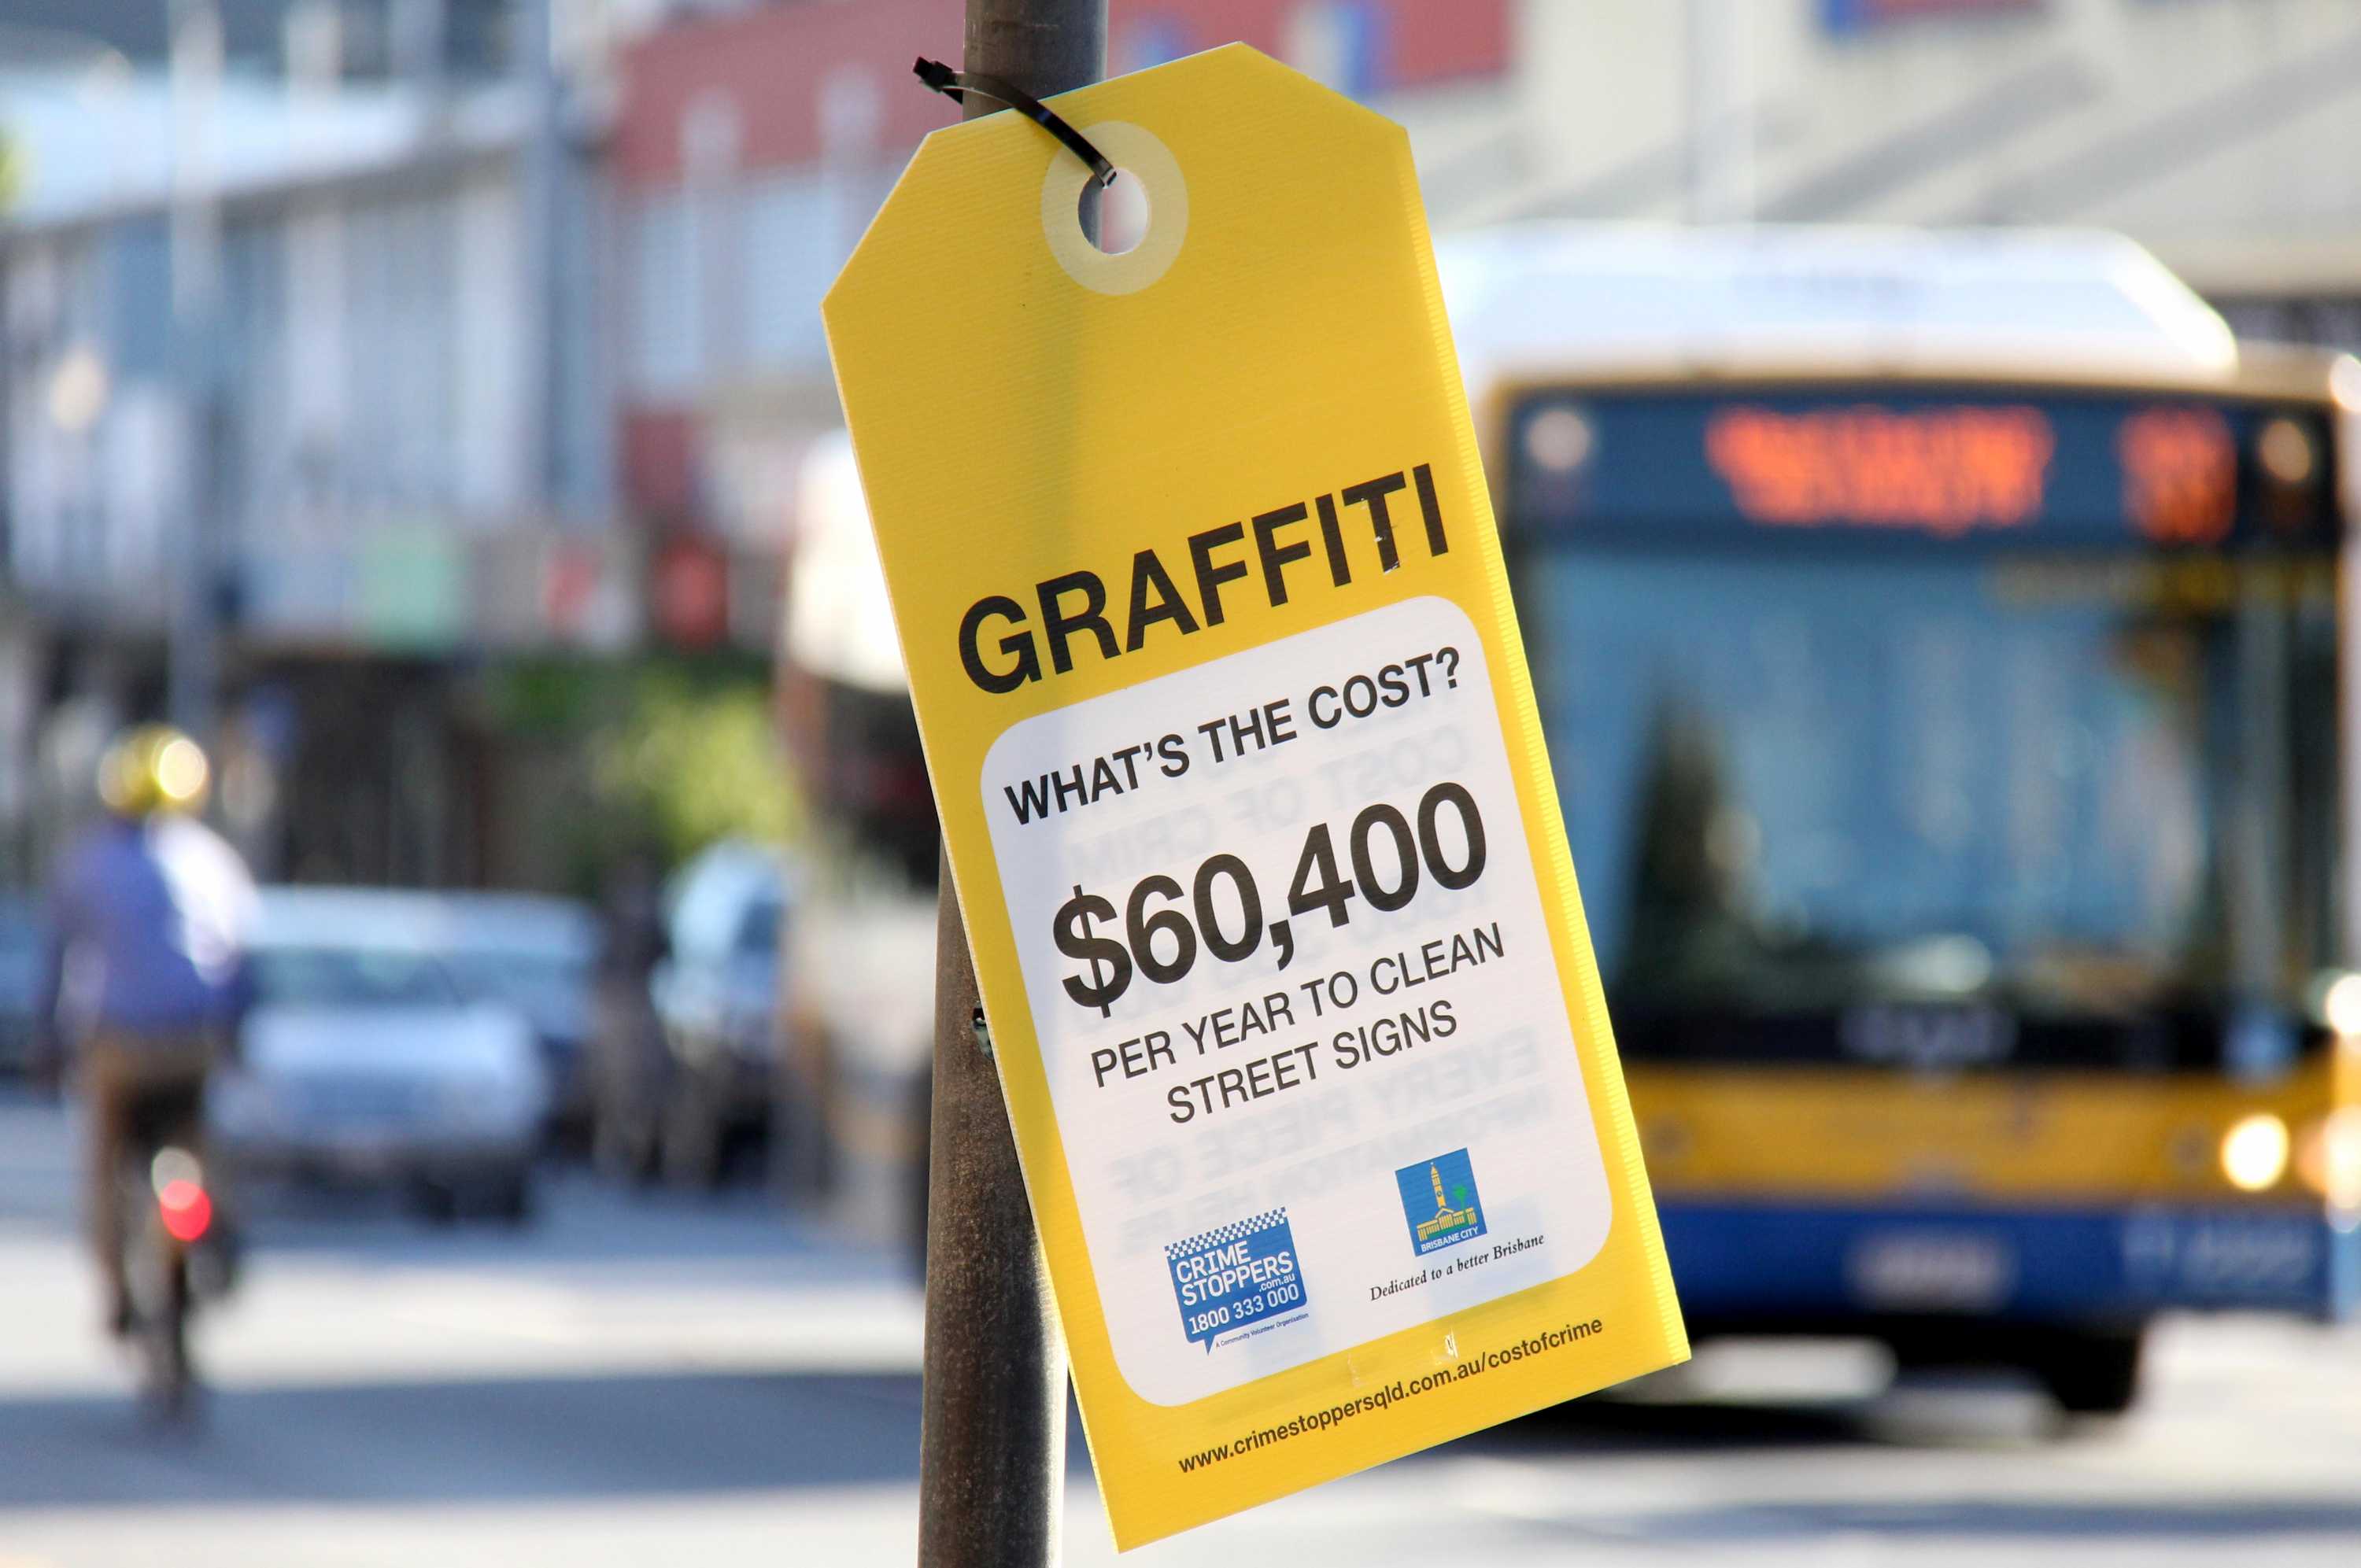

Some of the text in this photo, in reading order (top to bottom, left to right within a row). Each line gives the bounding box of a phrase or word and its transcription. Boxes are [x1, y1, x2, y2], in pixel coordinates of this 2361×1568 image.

[958, 463, 1449, 695] GRAFFITI
[1003, 646, 1461, 825] WHAT'S THE COST?
[1053, 782, 1487, 1019] $60,400
[1091, 922, 1505, 1087] PER YEAR TO CLEAN
[1167, 1000, 1457, 1123] STREET SIGNS
[1176, 1240, 1251, 1283] CRIME
[1370, 1234, 1545, 1301] Dedicated to a better Brisbane
[1421, 1226, 1480, 1253] BRISBANE CITY
[1181, 1251, 1294, 1306] STOPPERS
[1188, 1283, 1299, 1334] 1800 333 000
[1258, 1272, 1296, 1293] .com.au
[1221, 1332, 1251, 1347] Community
[1251, 1323, 1276, 1337] Volunteer
[1277, 1312, 1309, 1327] Organisation
[1178, 1317, 1603, 1474] www.crimestoppersqld.com.au/costofcrime
